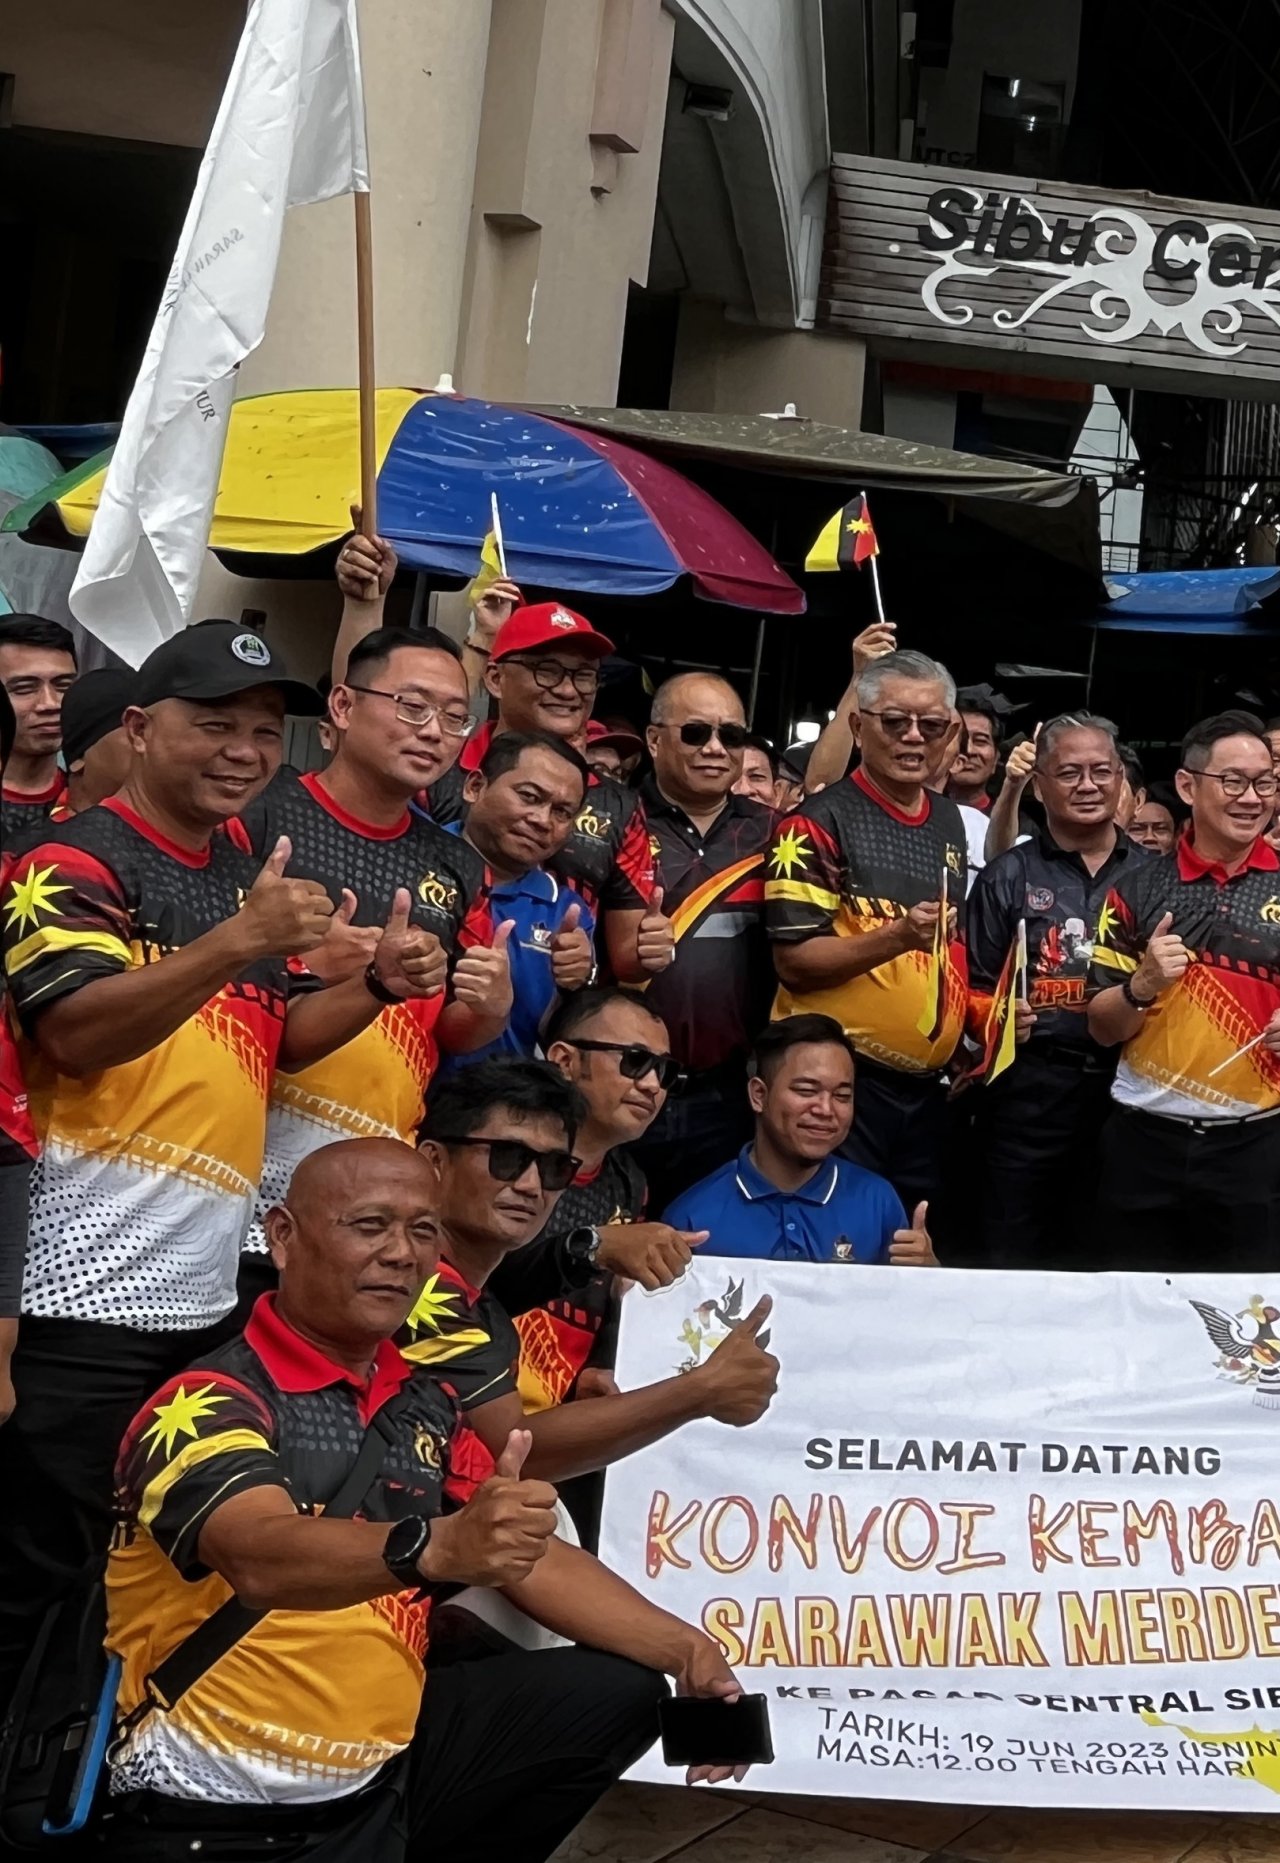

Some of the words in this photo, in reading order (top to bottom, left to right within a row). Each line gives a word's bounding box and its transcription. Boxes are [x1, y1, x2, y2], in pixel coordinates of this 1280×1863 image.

[918, 187, 1096, 266] Sibu
[804, 1437, 1027, 1472] SELAMAT
[1041, 1443, 1221, 1475] DATANG
[646, 1490, 1006, 1579] KONVOI
[700, 1591, 1051, 1668] SARAWAK
[818, 1706, 950, 1750] TARIKH:
[961, 1733, 993, 1753] 19
[1006, 1739, 1074, 1758] JUN
[1085, 1742, 1169, 1759] 2023
[1027, 1758, 1167, 1777] TENGAH
[1176, 1759, 1256, 1778] HARI
